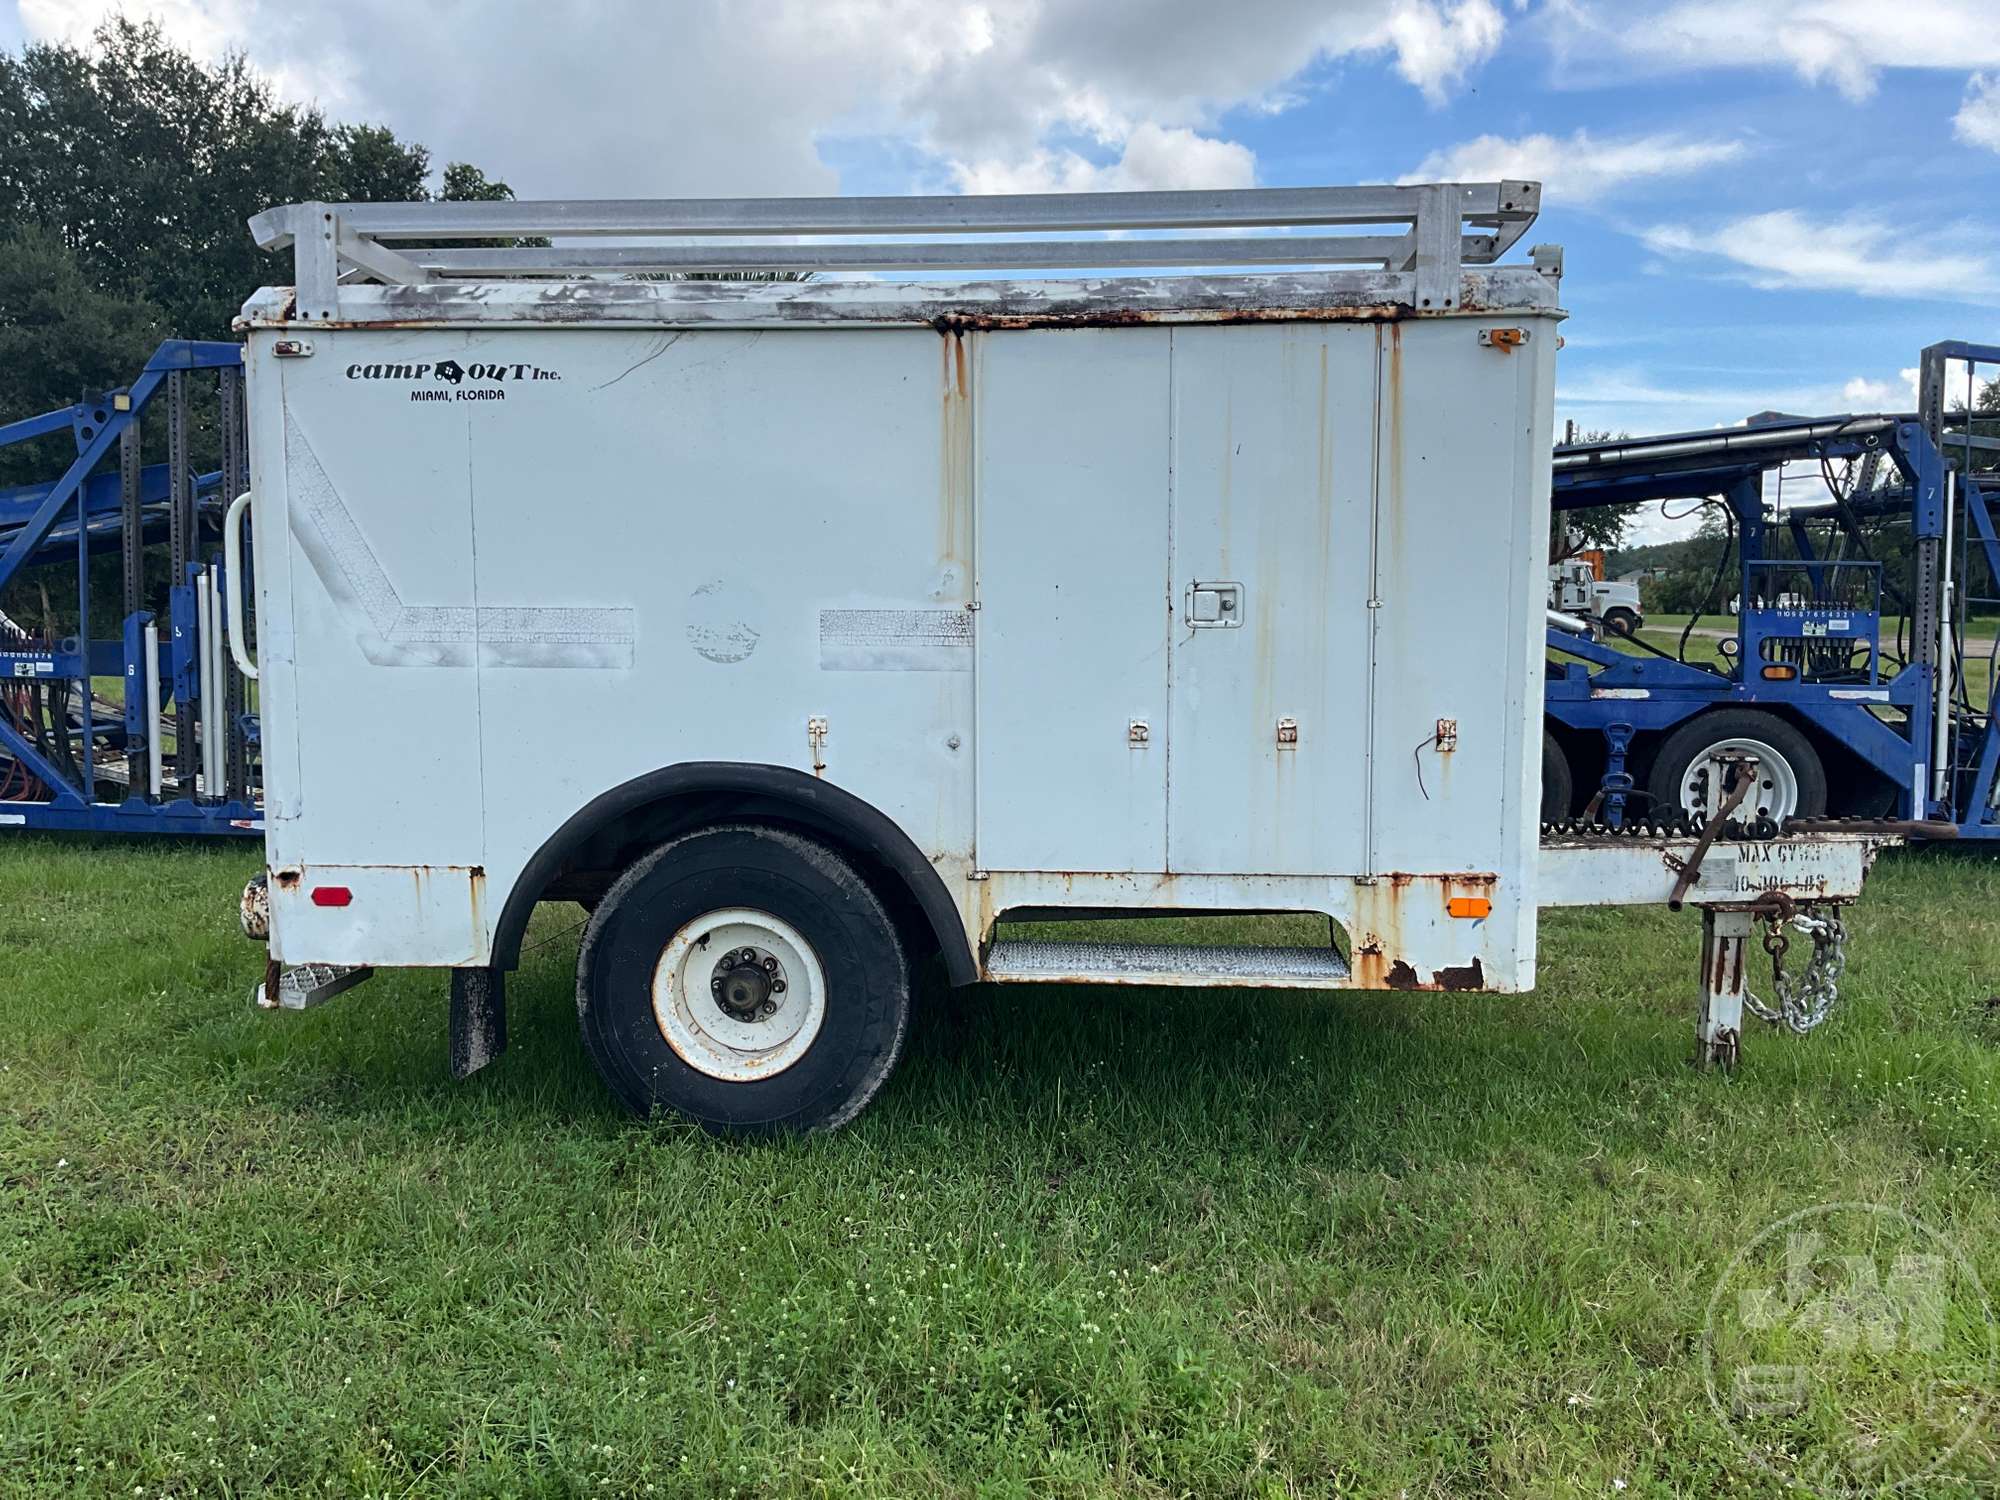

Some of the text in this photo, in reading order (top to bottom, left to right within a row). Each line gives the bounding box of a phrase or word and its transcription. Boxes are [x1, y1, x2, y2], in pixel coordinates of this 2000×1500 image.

[532, 368, 561, 380] Inc.
[411, 390, 505, 403] MIAMI, FLORIDA
[1928, 487, 1935, 500] 7
[128, 664, 135, 676] 6
[1739, 844, 1771, 863] MAX
